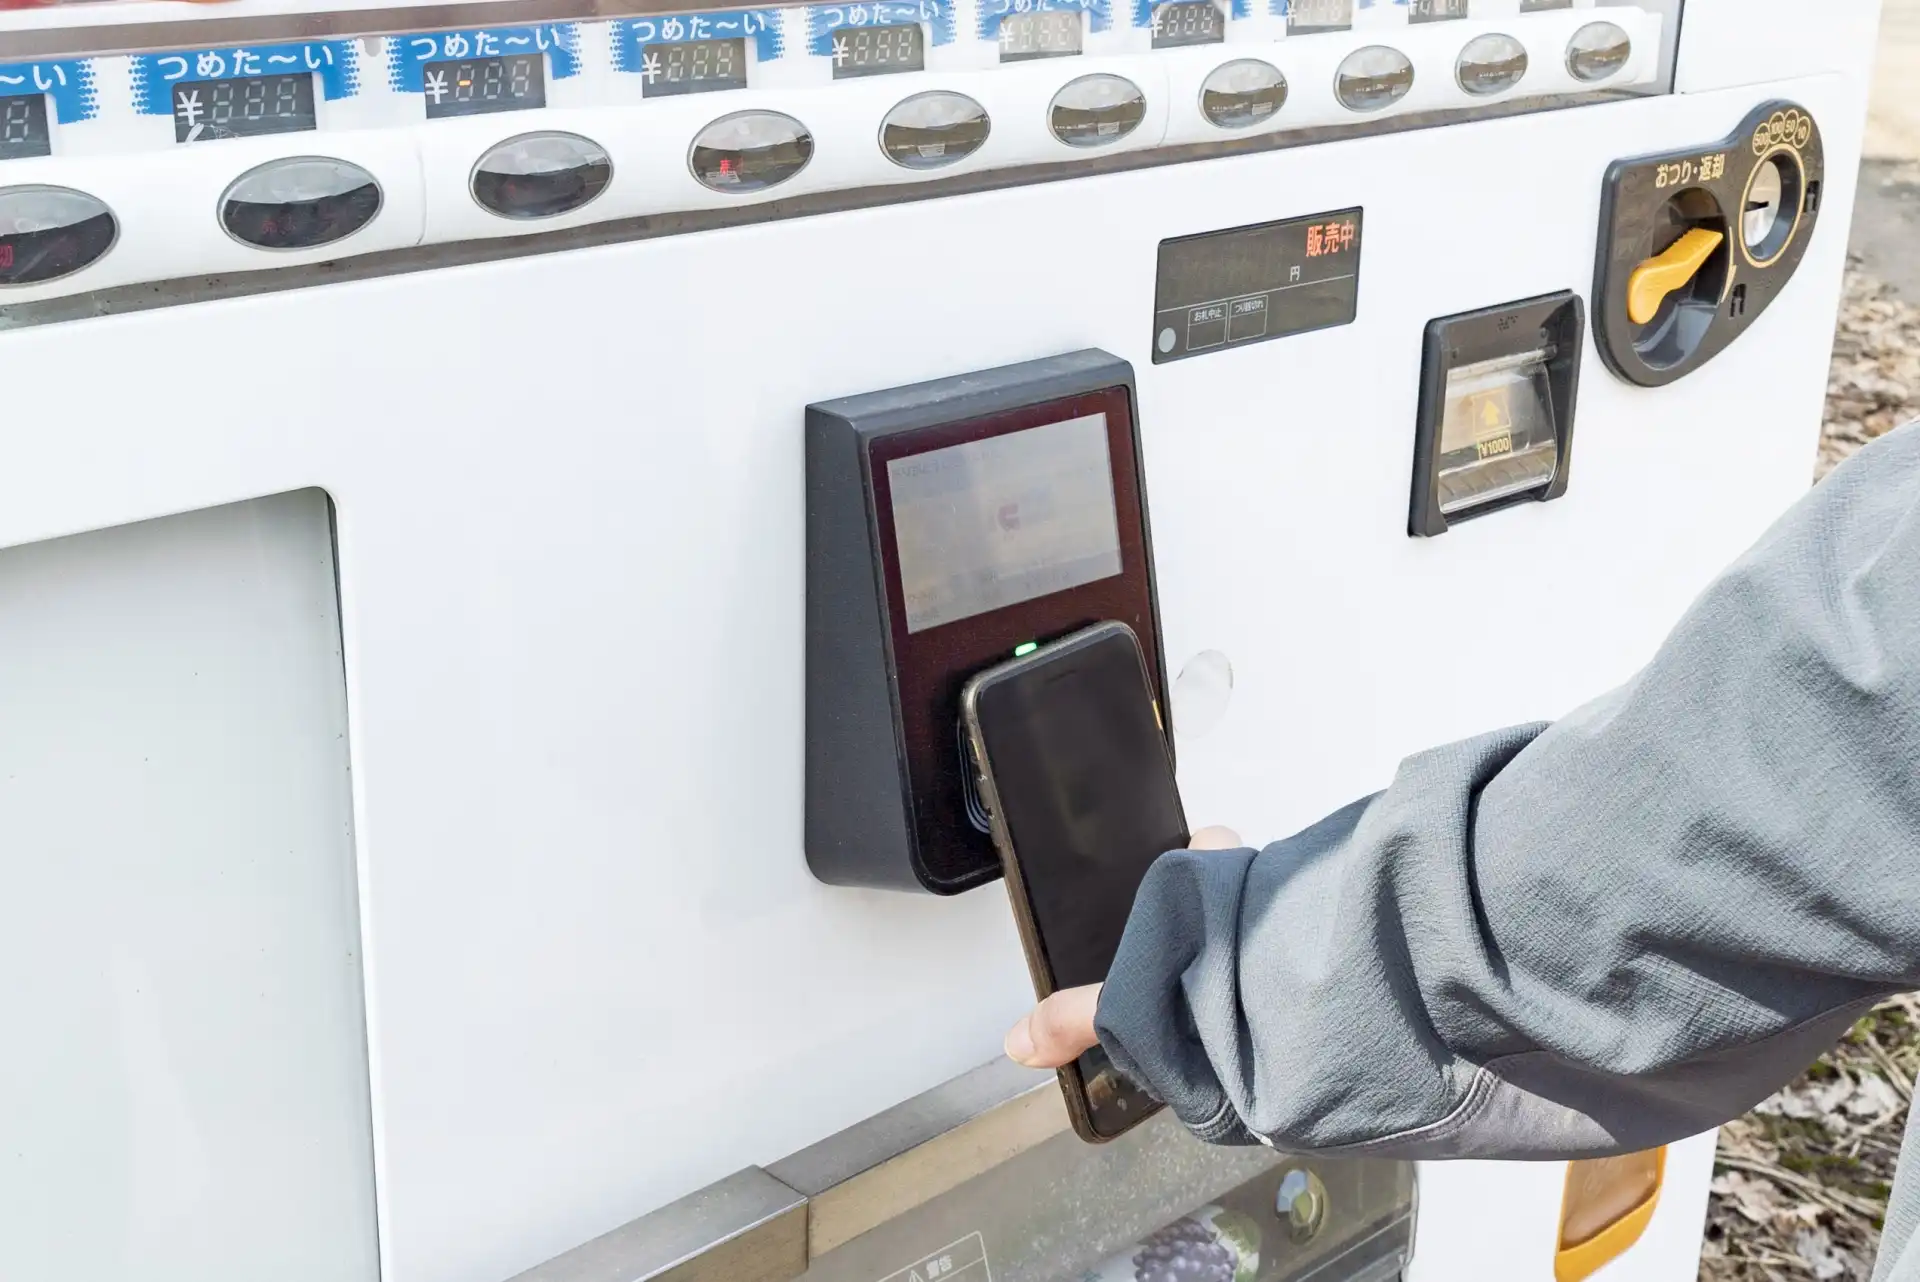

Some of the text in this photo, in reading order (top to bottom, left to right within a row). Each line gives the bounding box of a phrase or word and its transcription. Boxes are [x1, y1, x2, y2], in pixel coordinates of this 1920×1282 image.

[1306, 220, 1354, 257] 販売中
[1289, 265, 1301, 282] 円
